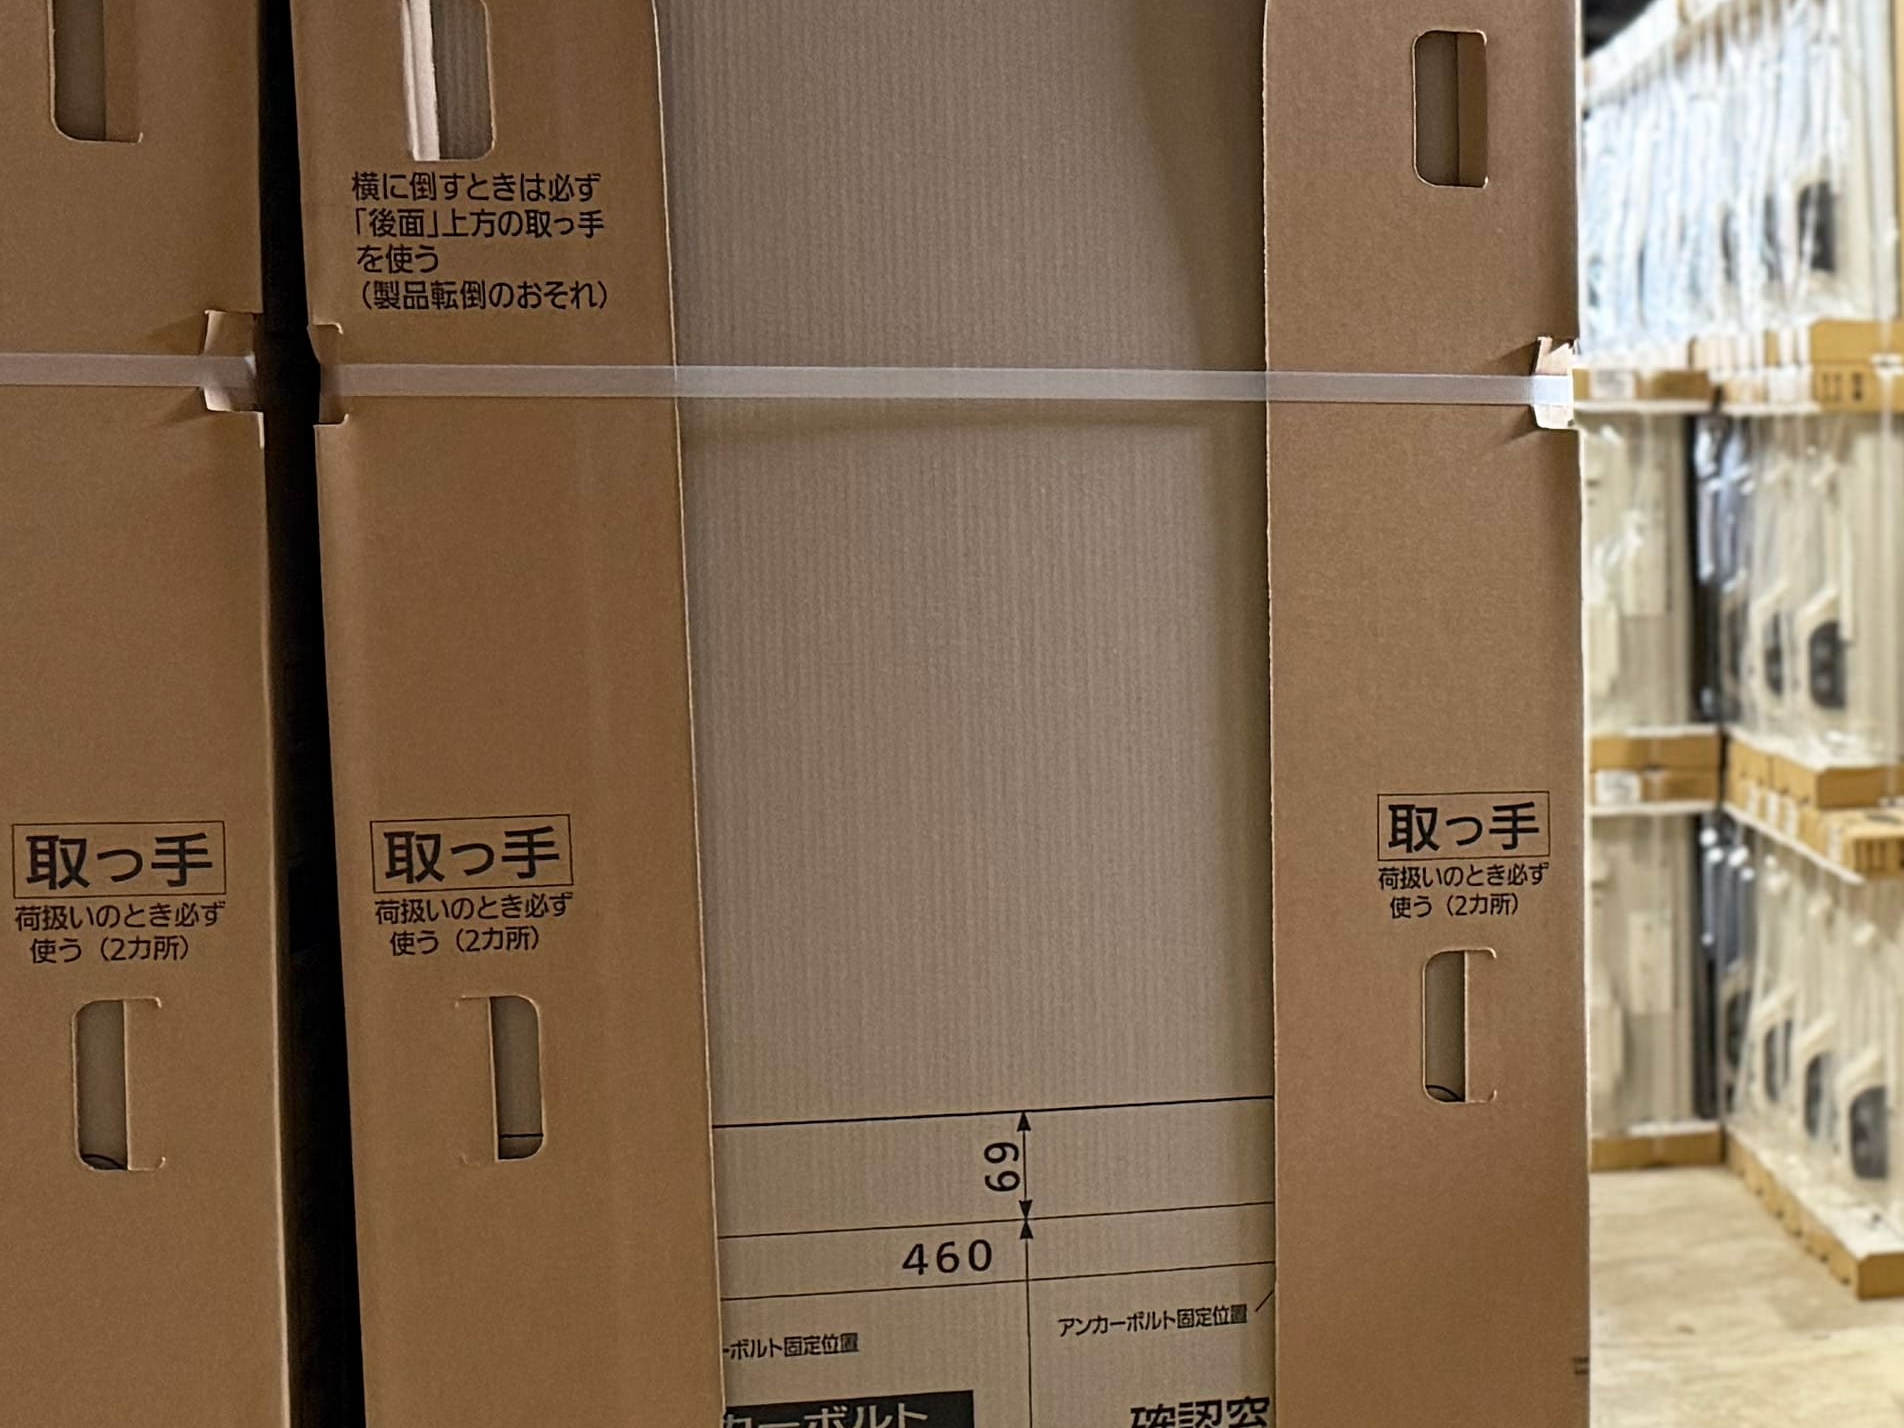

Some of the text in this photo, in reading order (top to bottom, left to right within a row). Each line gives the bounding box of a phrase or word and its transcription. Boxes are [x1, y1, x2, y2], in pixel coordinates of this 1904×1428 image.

[351, 174, 600, 203] 横に倒すときは必ず
[356, 208, 604, 238] 「後面」上方の取っ手
[357, 245, 439, 272] を使う
[361, 280, 607, 311] （製品転倒のおそれ）
[1387, 802, 1540, 853] 取っ手
[26, 833, 212, 890] 取っ手
[383, 826, 560, 884] 取っ手
[1379, 863, 1549, 891] 荷扱いのとき必ず
[16, 902, 226, 931] 荷扱いのとき必ず
[375, 893, 573, 926] 荷扱いのとき必ず
[984, 1142, 1020, 1192] 69
[902, 1239, 992, 1275] 460
[1058, 1304, 1246, 1338] アンカーボルト固定位置
